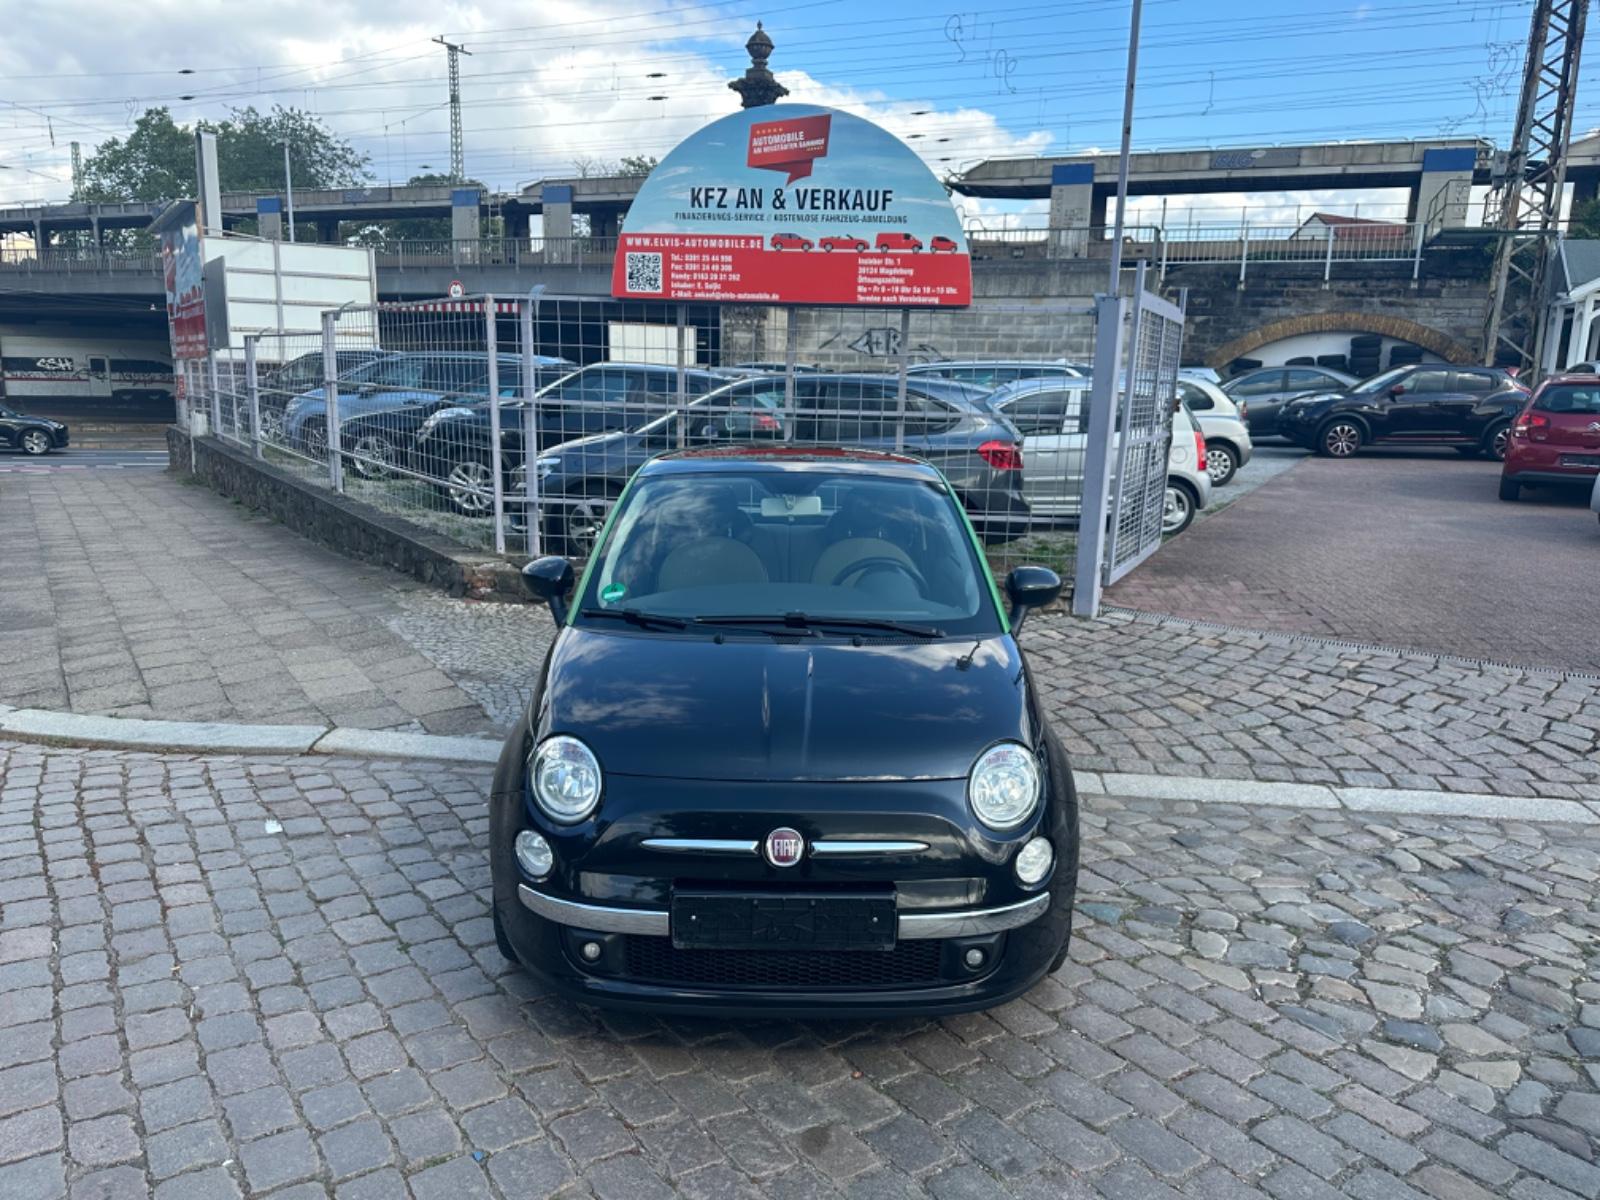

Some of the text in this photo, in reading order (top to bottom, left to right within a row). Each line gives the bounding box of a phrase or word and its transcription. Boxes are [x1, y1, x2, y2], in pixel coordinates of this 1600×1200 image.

[752, 131, 804, 147] AUTOMOBILE
[690, 187, 893, 211] KFZ AN & VERKAUF
[675, 212, 765, 222] FINANZIERUNGS-SERVICE
[774, 213, 819, 222] KOSTENLOSE
[820, 214, 908, 224] FAHRZEUG-ABMELDUNG
[626, 237, 762, 249] WWW.ELVIS-AUTOMOBILE.DE
[671, 272, 691, 281] Handy:
[879, 267, 914, 276] Magdeburg
[857, 275, 905, 285] Öffnungszeiten:
[882, 295, 897, 303] nach
[899, 296, 939, 304] Vereinbarung
[774, 839, 796, 857] FIAT
